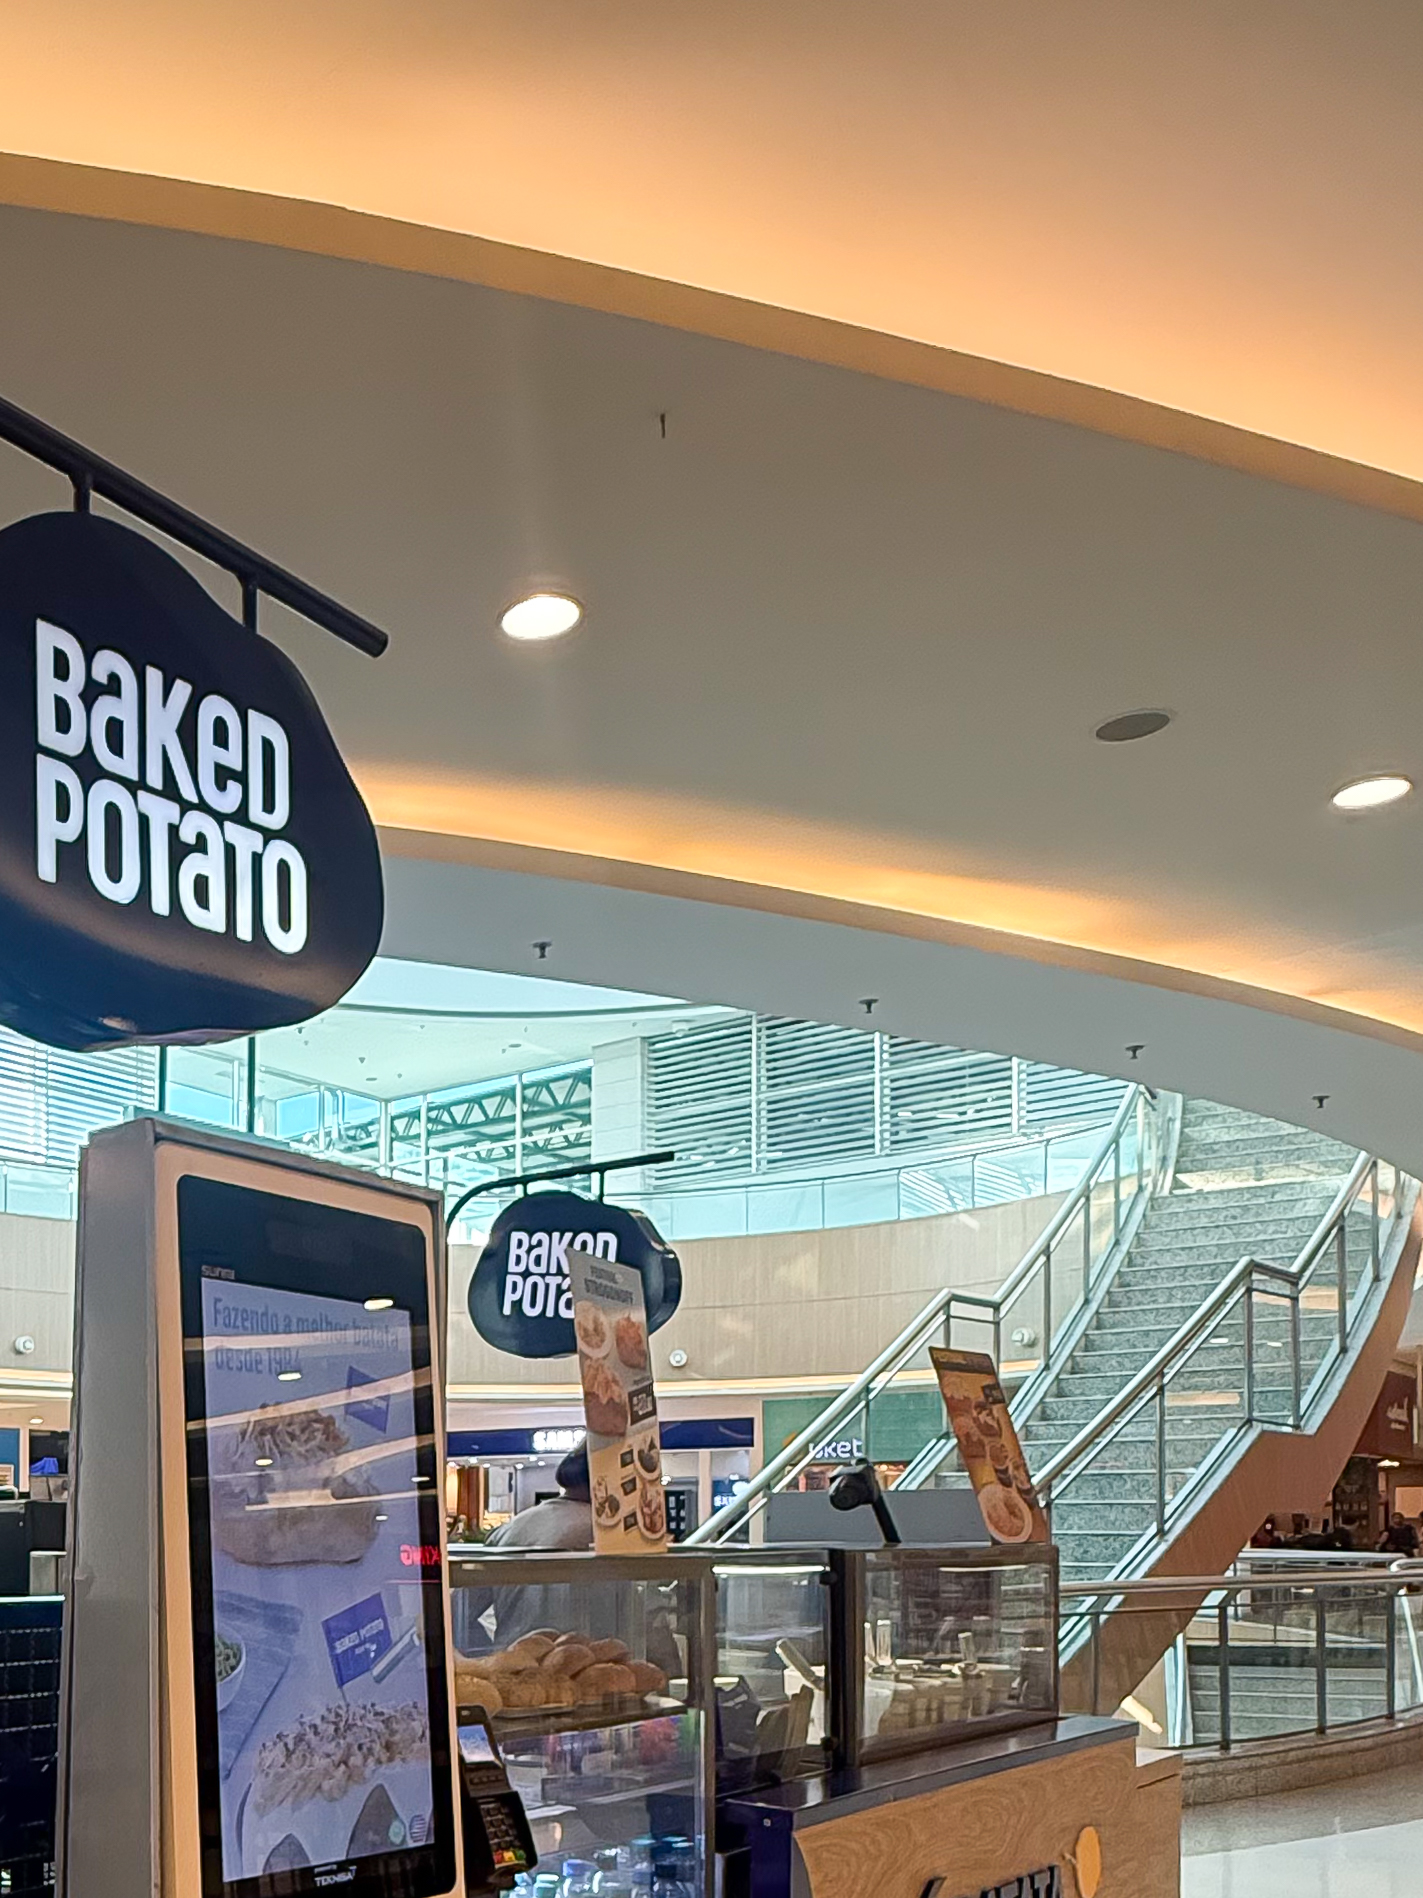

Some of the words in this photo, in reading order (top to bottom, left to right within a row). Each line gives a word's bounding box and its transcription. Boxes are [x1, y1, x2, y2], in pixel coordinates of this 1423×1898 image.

[213, 1298, 279, 1333] Fazendo
[284, 1317, 292, 1333] a
[296, 1311, 349, 1343] melhor
[216, 1345, 263, 1374] desde
